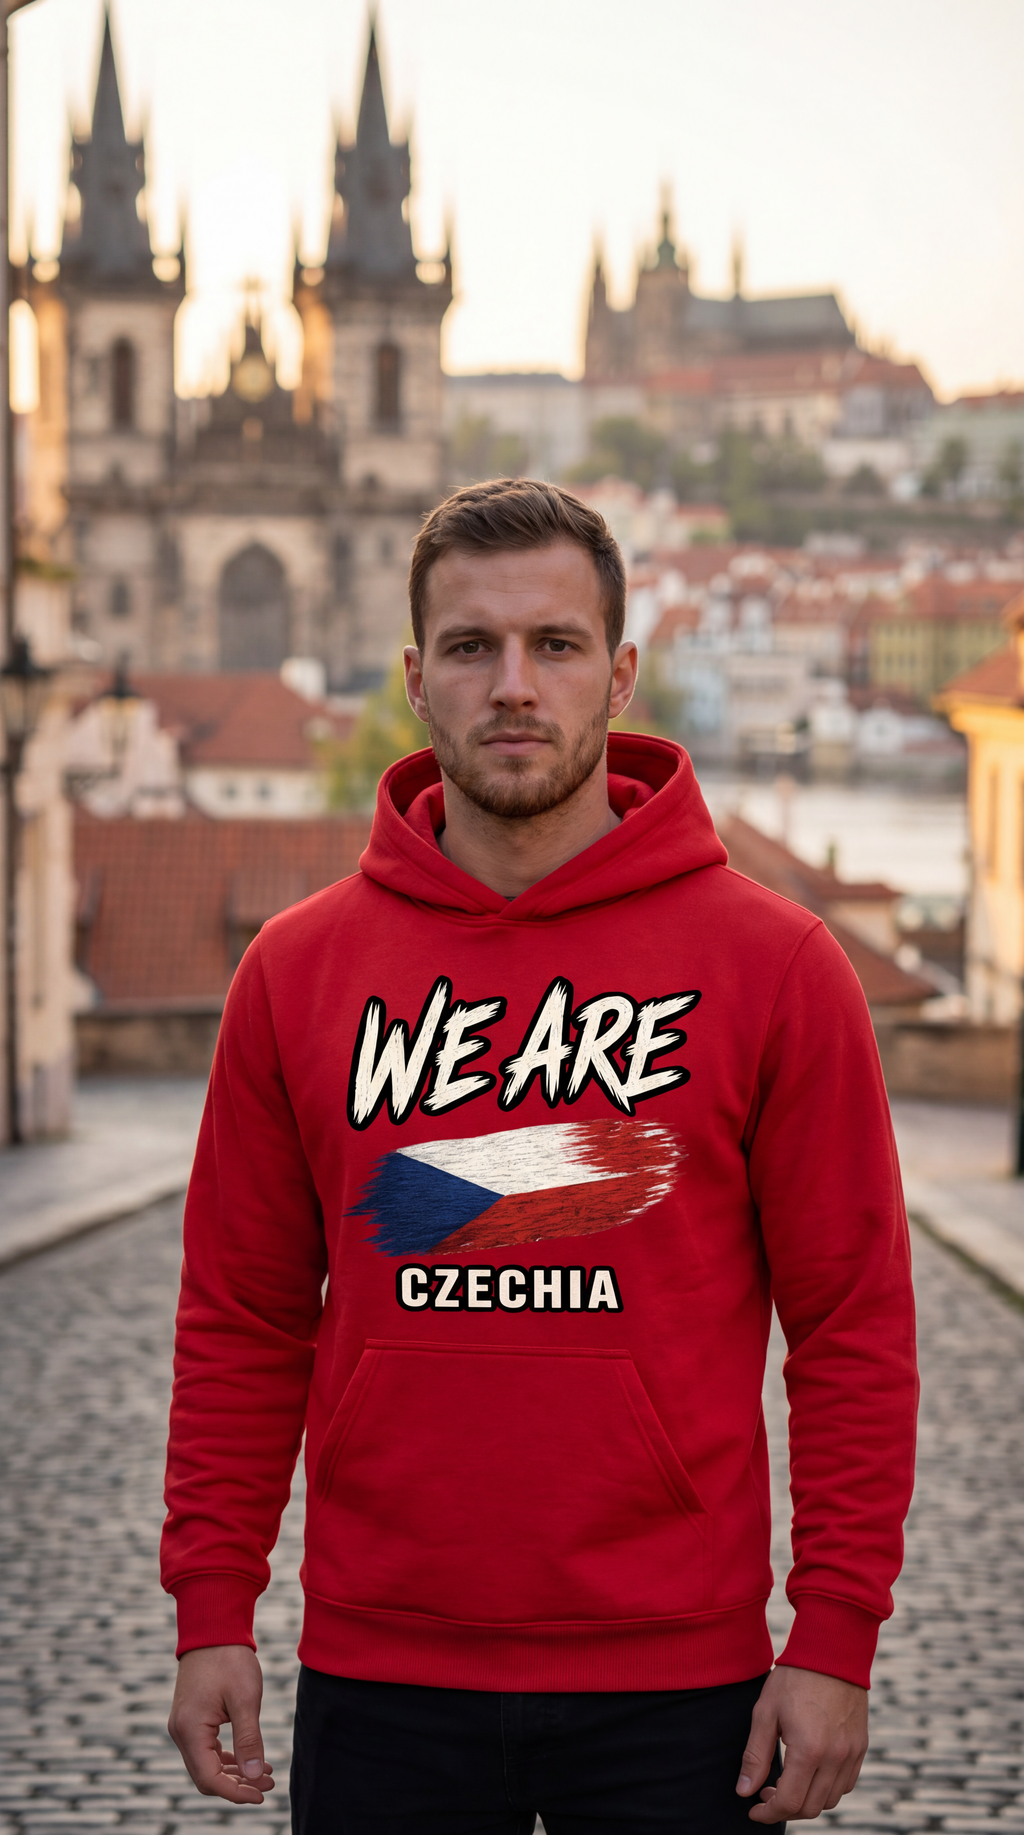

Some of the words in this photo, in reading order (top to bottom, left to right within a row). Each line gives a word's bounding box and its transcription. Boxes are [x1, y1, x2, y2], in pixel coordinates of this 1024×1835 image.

[351, 979, 503, 1126] WE
[501, 979, 698, 1114] ARE
[399, 1266, 621, 1310] CZECHIA
